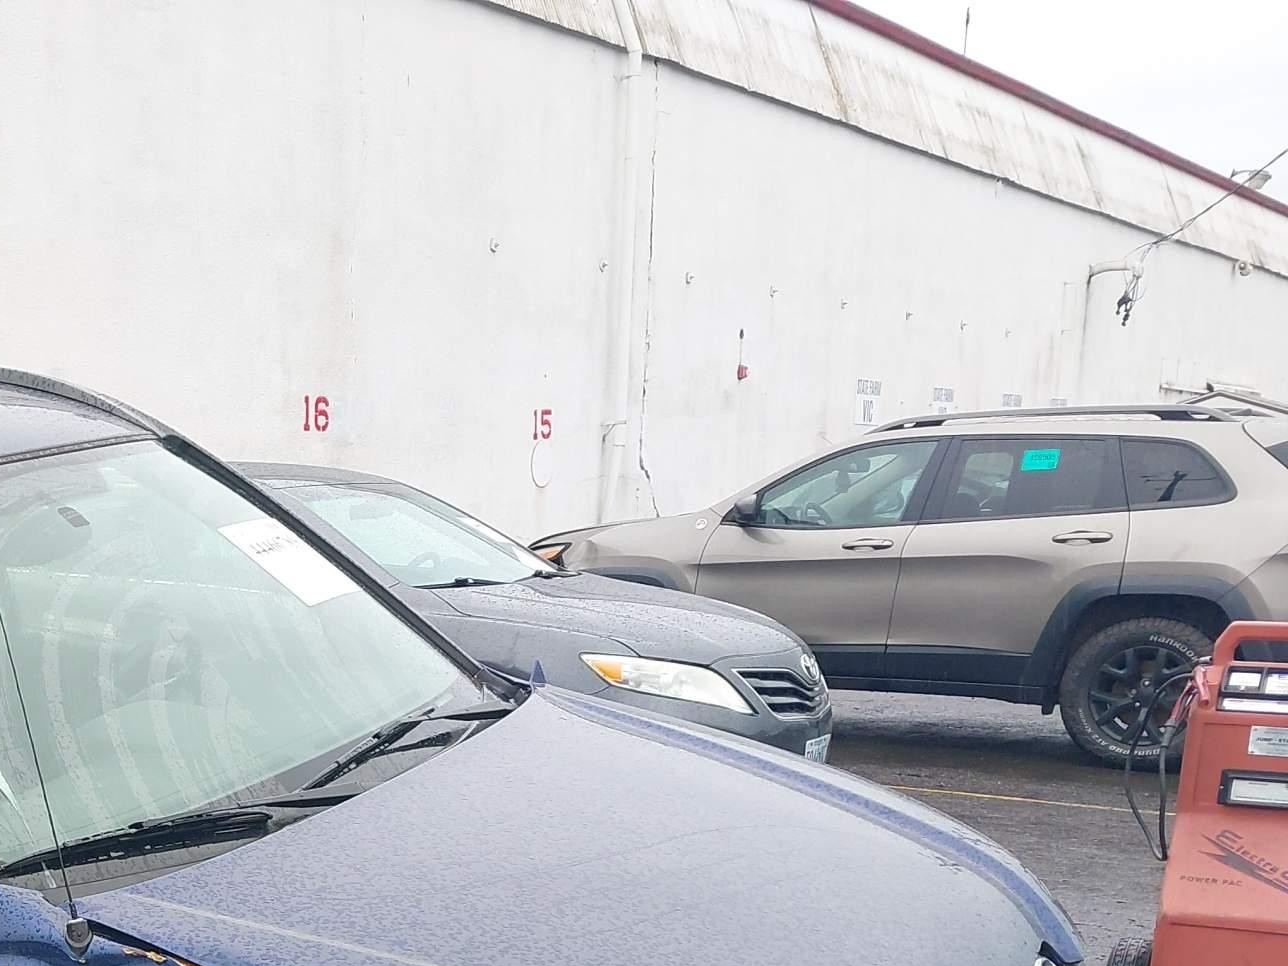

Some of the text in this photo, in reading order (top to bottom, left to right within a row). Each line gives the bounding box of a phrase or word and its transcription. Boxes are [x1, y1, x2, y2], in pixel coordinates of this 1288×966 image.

[303, 395, 330, 432] 16
[533, 409, 553, 440] 15
[862, 399, 874, 423] VIC
[1179, 875, 1218, 885] POWER
